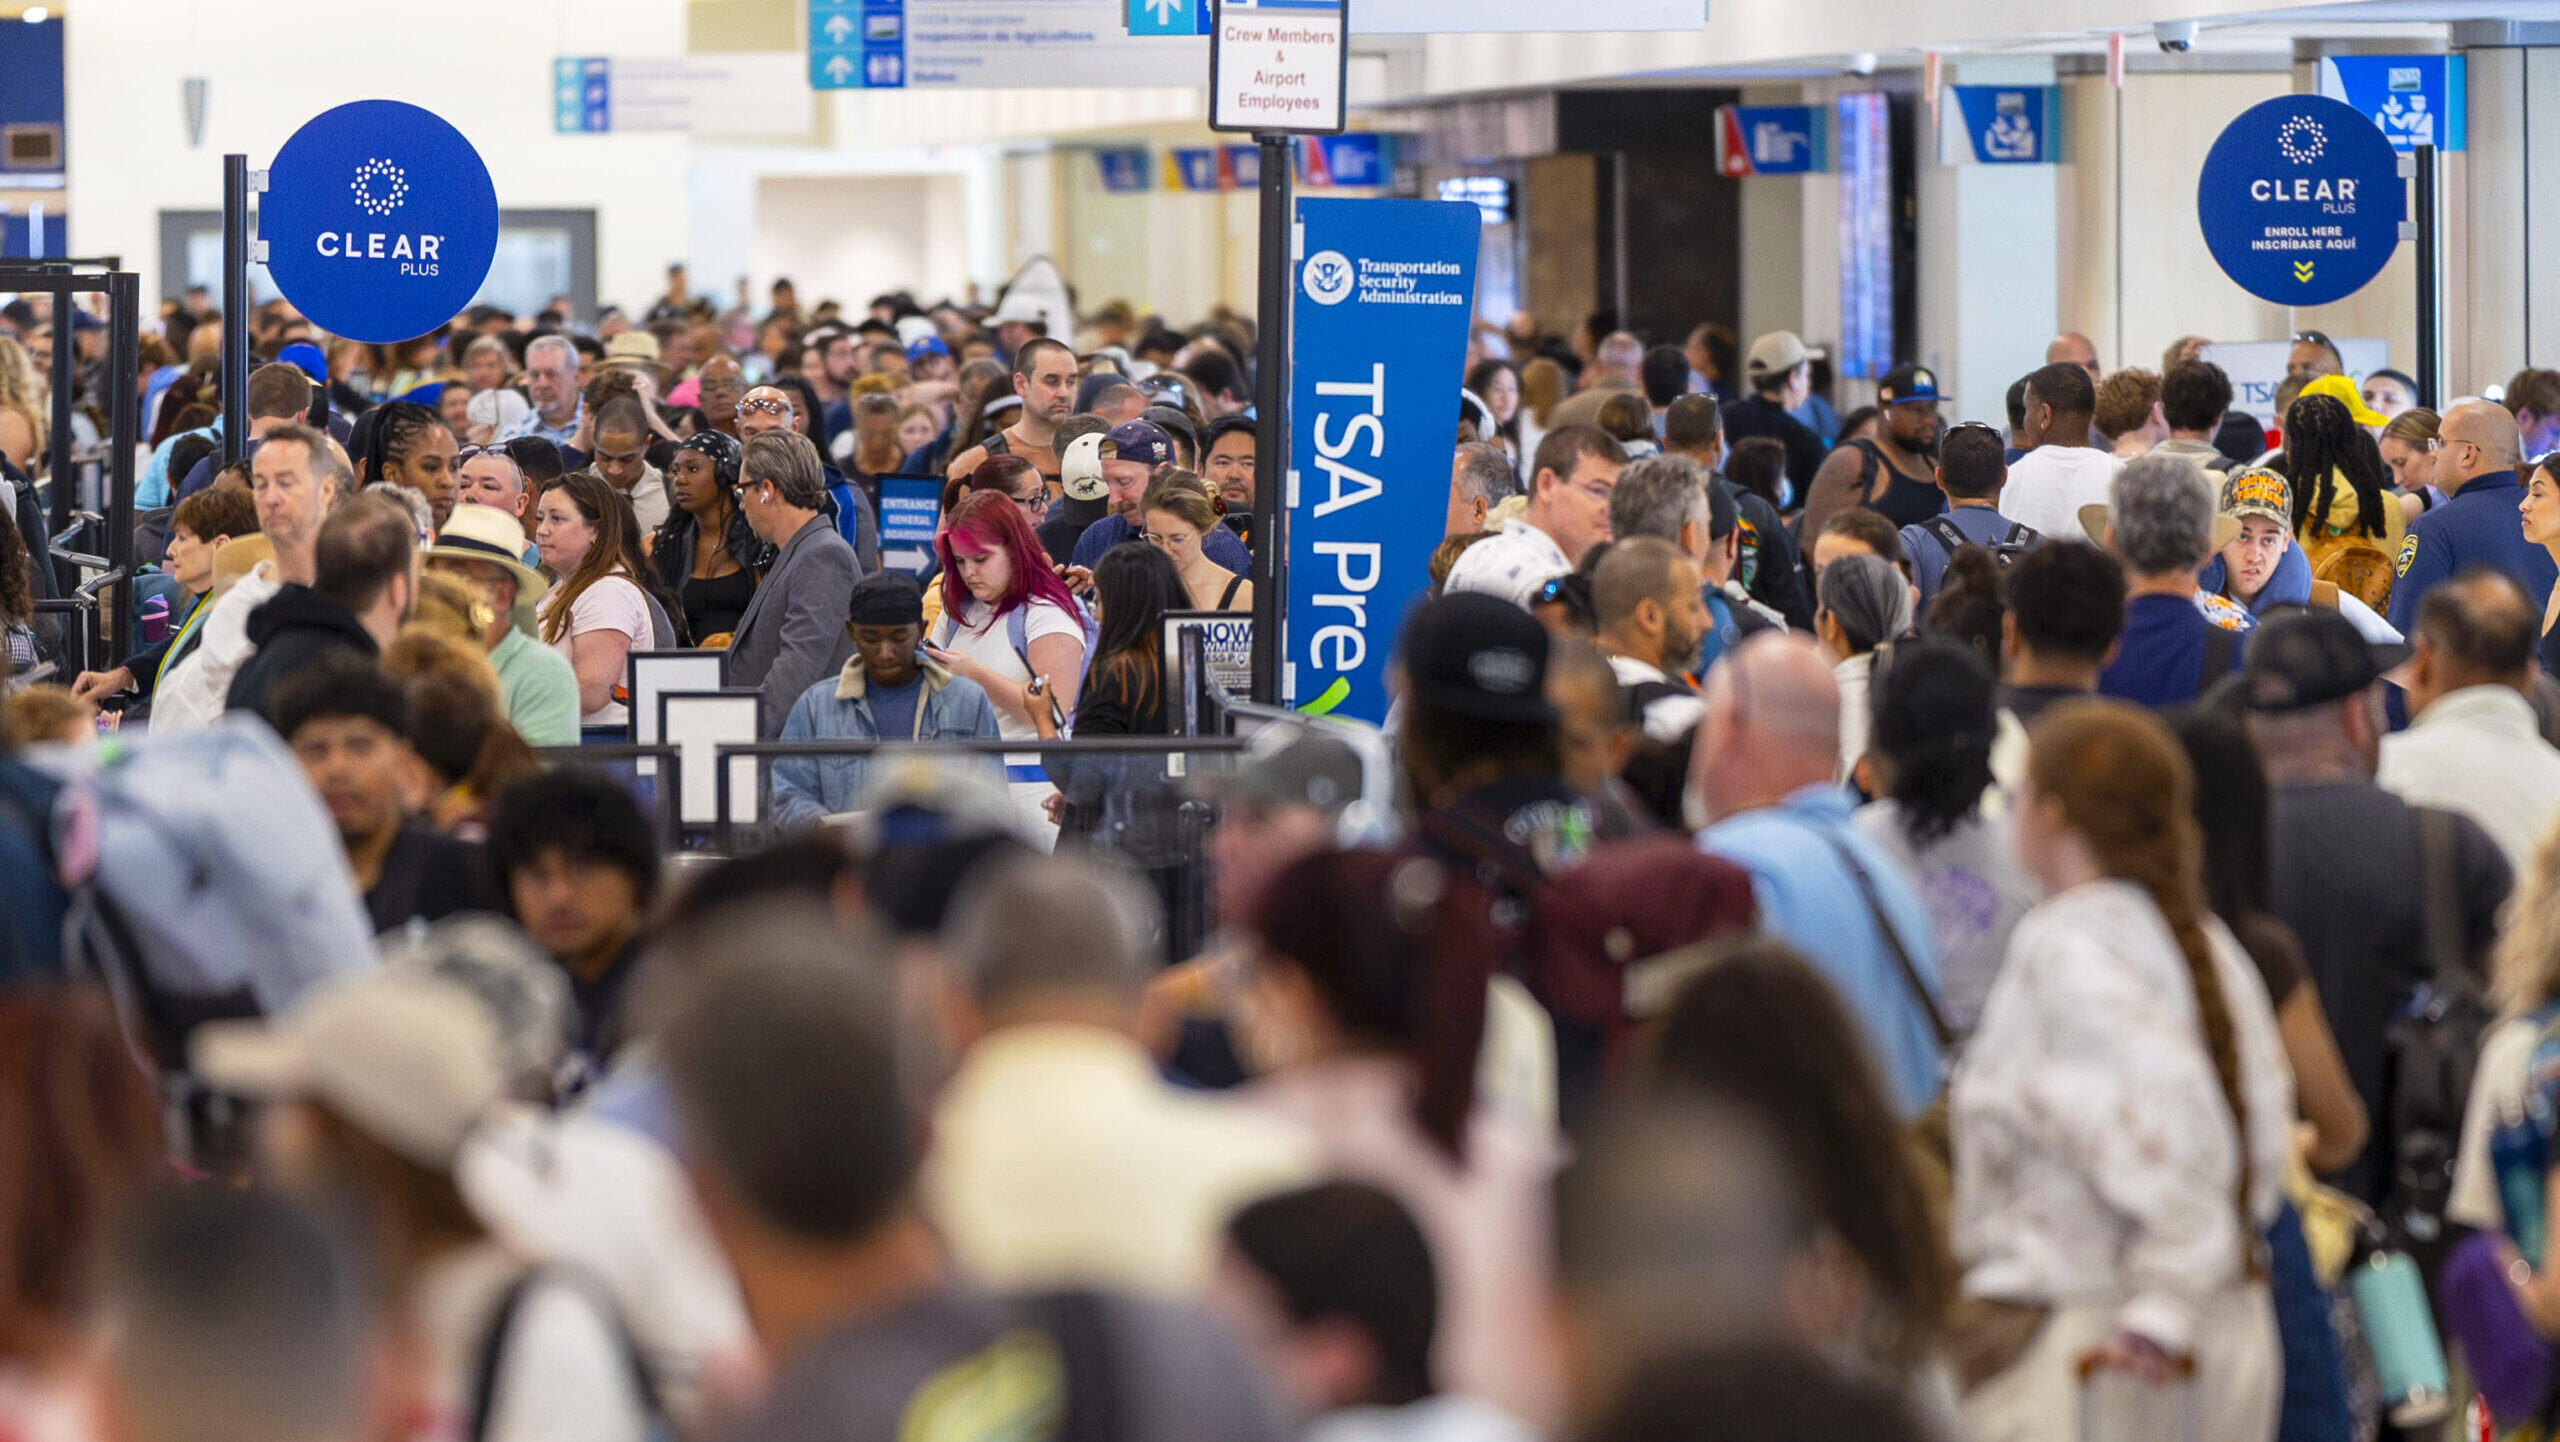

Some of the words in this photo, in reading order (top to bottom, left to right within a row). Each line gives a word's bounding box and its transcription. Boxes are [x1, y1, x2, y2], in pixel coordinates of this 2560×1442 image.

[1225, 26, 1262, 42] Crew
[1267, 28, 1335, 44] Members
[1275, 50, 1285, 62] &
[1253, 70, 1305, 88] Airport
[1238, 93, 1320, 112] Employees
[2322, 202, 2356, 214] PLUS
[2264, 226, 2308, 237] ENROLL
[2312, 225, 2343, 236] HERE
[2251, 237, 2323, 250] INSCRÍBASE
[2326, 236, 2356, 250] AQUÍ
[400, 262, 439, 276] PLUS
[1358, 258, 1461, 276] Transportation
[1358, 275, 1417, 291] Security
[1358, 289, 1463, 305] Administration
[1313, 363, 1385, 519] TSA
[881, 498, 939, 511] ENTRANCE
[1309, 541, 1382, 672] Pre
